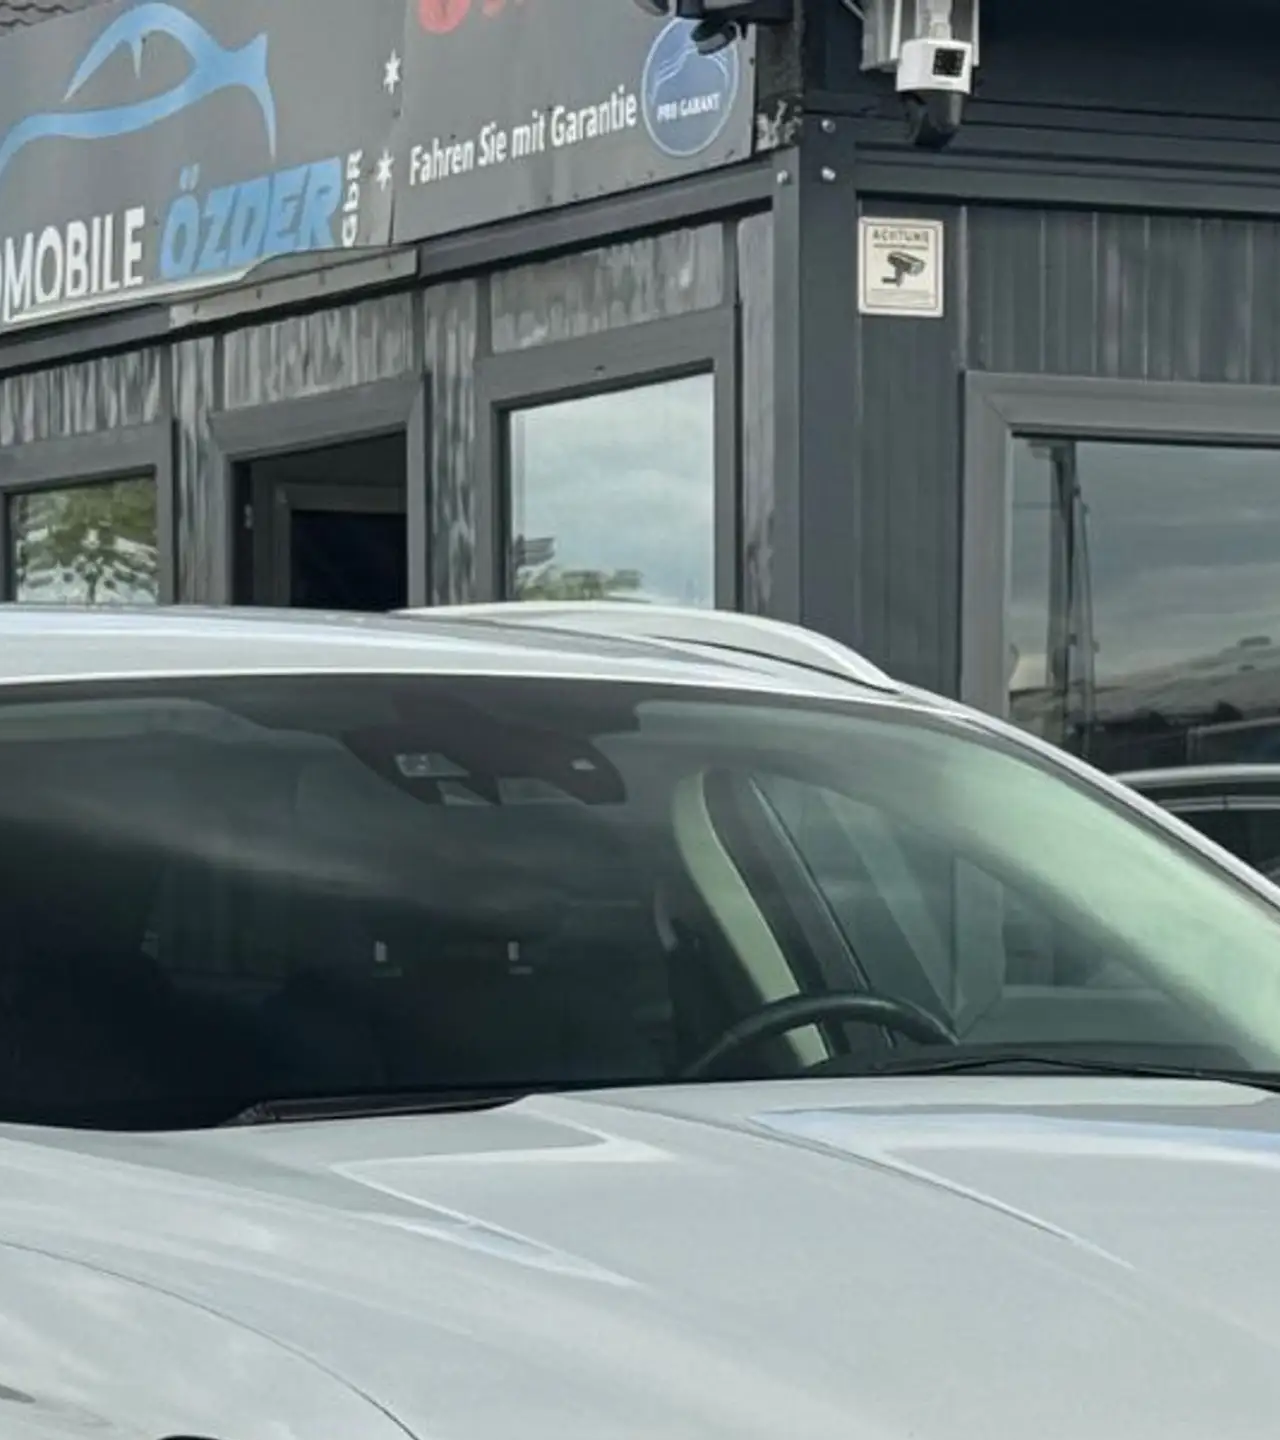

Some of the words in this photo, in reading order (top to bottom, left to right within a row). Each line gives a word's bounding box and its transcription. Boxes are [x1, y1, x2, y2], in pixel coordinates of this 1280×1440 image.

[409, 134, 475, 186] Fahren
[477, 122, 508, 167] Sie
[510, 113, 546, 158] mit
[550, 85, 638, 147] Garantie
[679, 93, 720, 116] GARANT
[160, 156, 342, 280] ÖZDER
[341, 150, 363, 248] GbR
